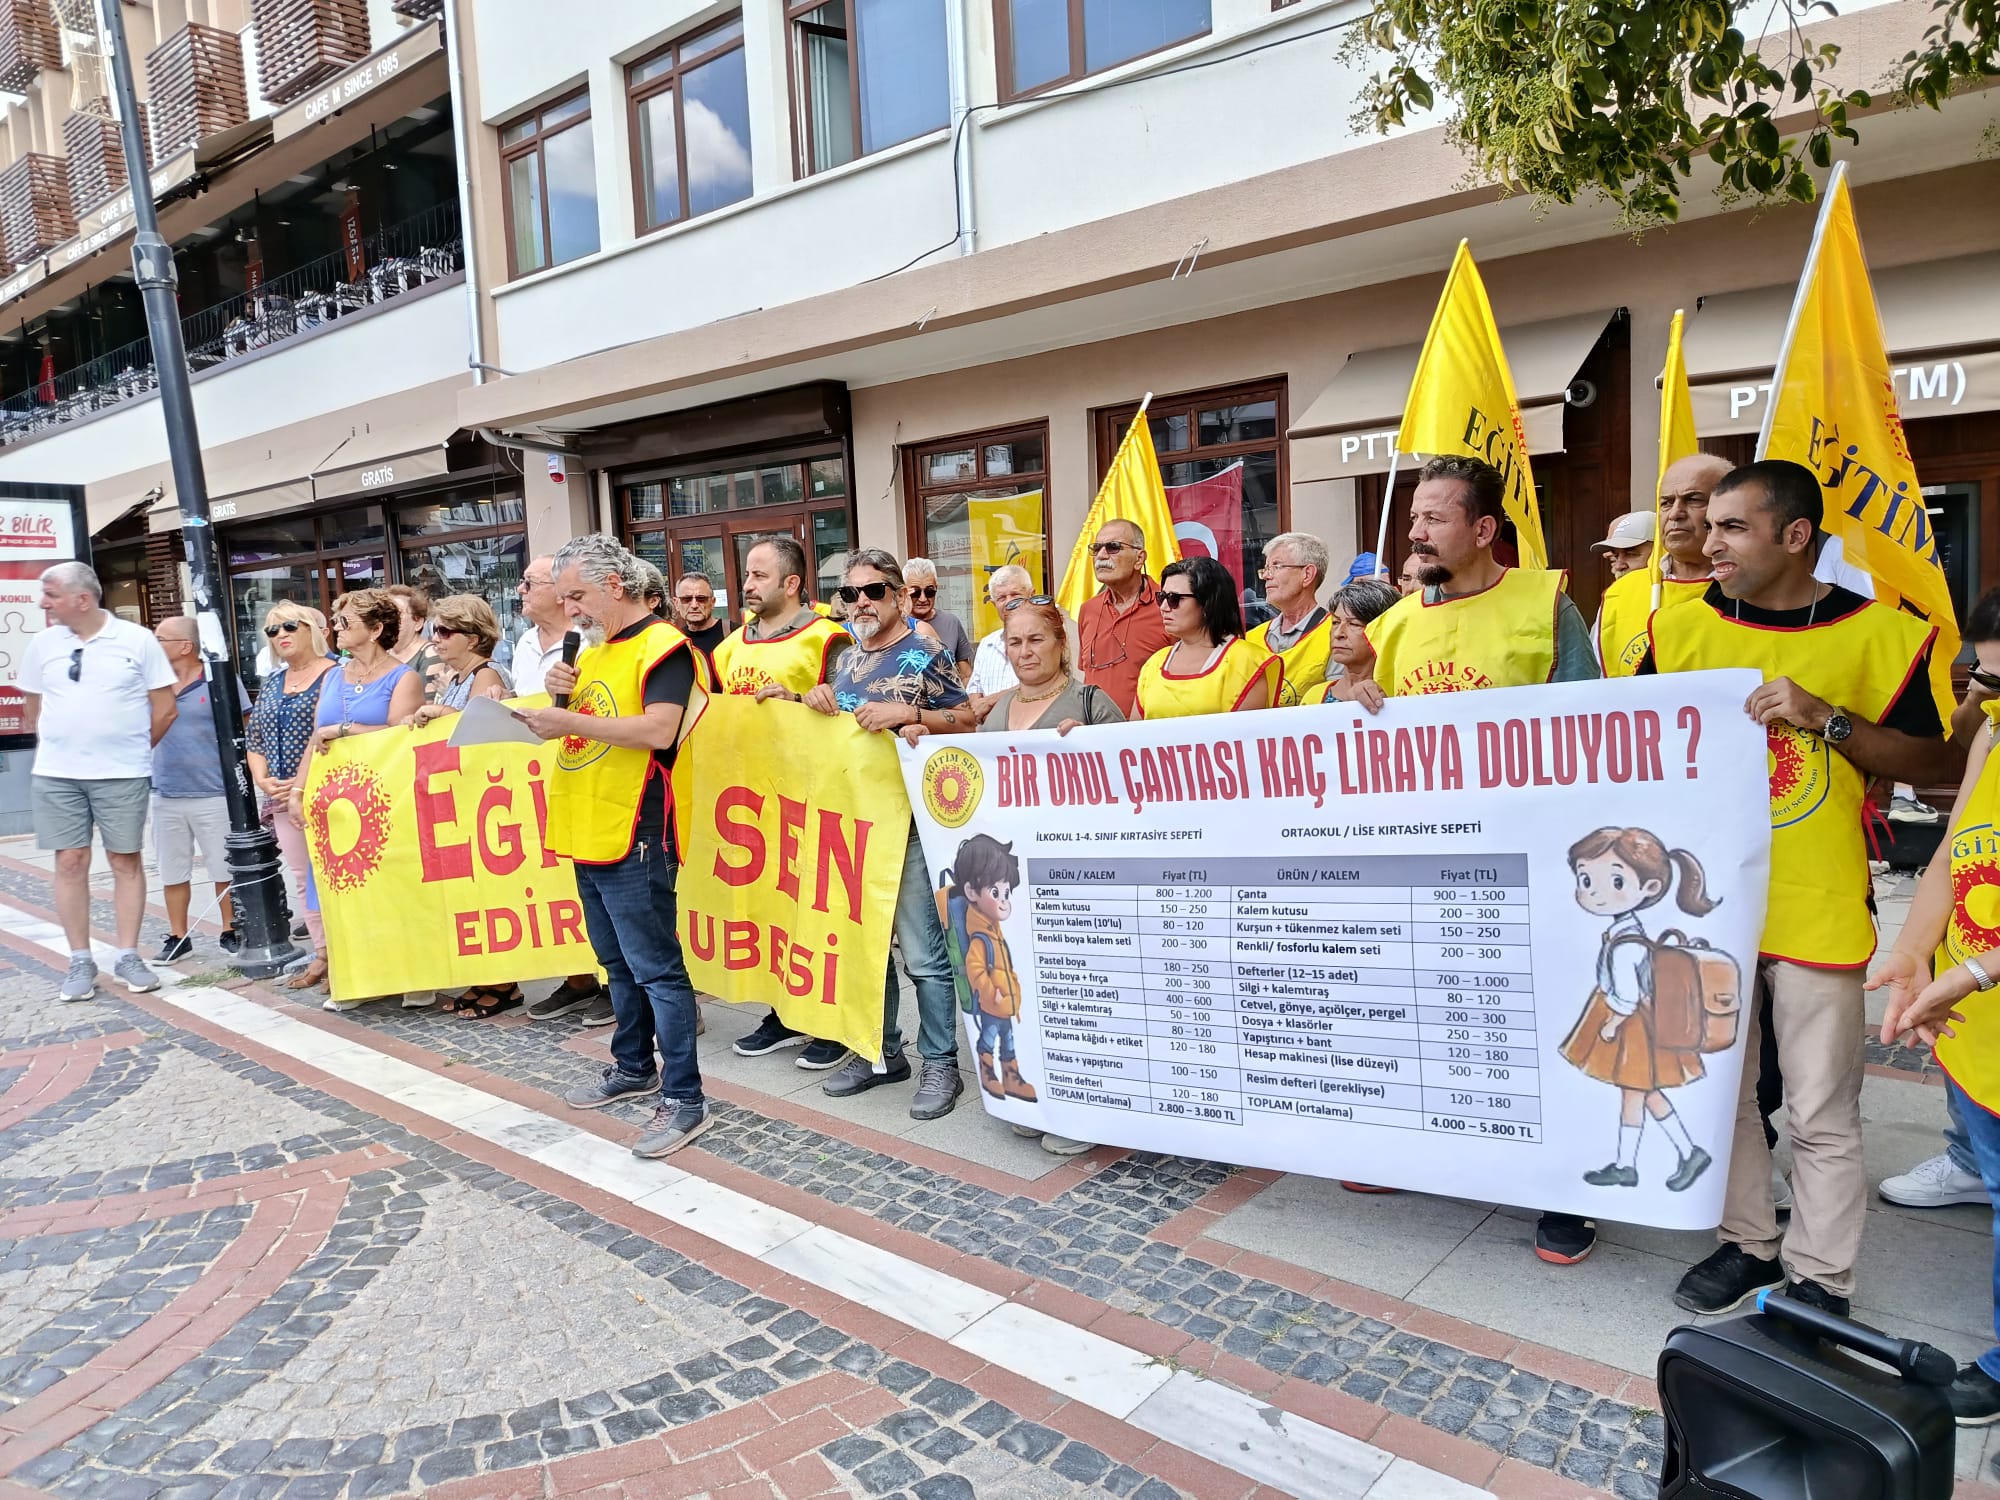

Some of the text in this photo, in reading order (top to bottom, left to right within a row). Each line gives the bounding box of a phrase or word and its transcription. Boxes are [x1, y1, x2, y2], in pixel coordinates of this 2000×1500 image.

[305, 52, 399, 119] CAFE M SINCE 1985
[100, 203, 119, 224] CAFE
[1341, 430, 1400, 463] PTT
[1462, 406, 1531, 518] EĞİT
[361, 465, 394, 487] GRATİS
[212, 500, 237, 519] GRATİS
[0, 594, 36, 604] KOKUL
[1624, 638, 1650, 666] EĞİ
[756, 670, 774, 685] SE
[1461, 665, 1494, 690] SE
[925, 752, 980, 783] EĞİTİM SEN
[996, 746, 1040, 808] BİR
[1046, 751, 1119, 806] OKUL
[1119, 740, 1250, 815] ÇANTASI
[1256, 734, 1327, 809] KAÇ
[1336, 718, 1464, 795] LİRAYA
[1476, 709, 1664, 789] DOLUYOR
[1677, 705, 1702, 780] ?
[413, 739, 560, 882] EĞİ
[712, 785, 874, 926] SEN
[1036, 832, 1074, 842] İLKOKUL
[1095, 831, 1119, 841] SINIF
[1121, 830, 1169, 841] KIRTASİYE
[1171, 830, 1203, 839] SEPETİ
[1282, 821, 1482, 838] ORTAOKUL LİSE KIRTASİYE SEPETİ
[1951, 836, 1999, 860] ĞİT
[1049, 869, 1116, 880] ÜRÜN KALEM
[1163, 870, 1208, 882] Fiyat (TL)
[1277, 868, 1361, 880] ÜRÜN KALEM
[1441, 868, 1498, 881] Fiyat (TL)
[1036, 888, 1060, 898] Çanta
[1156, 889, 1213, 899] 800 1.200
[1238, 889, 1268, 900] Çanta
[1434, 890, 1506, 901] 900 1.500
[1036, 902, 1091, 911] Kalem kutusu
[1237, 905, 1309, 916] Kalem kutusu
[1037, 917, 1065, 927] Kurşun
[1066, 918, 1093, 926] kalem
[1163, 920, 1204, 931] 80 120
[1237, 922, 1402, 936] Kurşun tükenmez kalem seti
[1038, 934, 1132, 946] Renkli boya kalem seti
[1441, 927, 1501, 938] 150 250
[454, 887, 840, 1005] EDİR UBESİ
[1237, 941, 1381, 955] Renkli/ fosforlu kalem seti
[1039, 956, 1089, 968] Pastel boya
[1164, 963, 1210, 974] 180 250
[1040, 970, 1109, 984] Sulu boya fırça
[1238, 967, 1285, 978] Defterler
[1328, 970, 1359, 983] adet)
[1437, 975, 1510, 988] 700 1.000
[1042, 986, 1120, 1001] Defterler (10 adet)
[1239, 983, 1330, 998] Silgi kalemtıraş
[1166, 994, 1213, 1006] 400 600
[1043, 1001, 1113, 1016] Silgi kalemtıraş
[1241, 999, 1406, 1020] Cetvel, gönye, açıölçer, pergel
[1044, 1015, 1098, 1028] Cetvel takımı
[1242, 1015, 1334, 1031] Dosya klasörler
[1445, 1011, 1507, 1024] 200 300
[1045, 1030, 1080, 1043] Kaplama
[1114, 1036, 1144, 1047] etiket
[1172, 1026, 1212, 1038] 80 120
[1243, 1031, 1333, 1048] Yapıştırıcı bant
[1047, 1052, 1124, 1069] Makas yapıştırıcı
[1245, 1047, 1399, 1071] Hesap makinesi (lise düzeyi)
[1448, 1047, 1509, 1061] 120 180
[1172, 1066, 1218, 1079] 100 150
[1050, 1073, 1103, 1088] Resim defteri
[1247, 1073, 1386, 1098] Resim defteri (gerekliyse)
[1051, 1088, 1132, 1108] TOPLAM (ortalama)
[1159, 1103, 1236, 1121] 2.800 3.800 TL
[1248, 1097, 1354, 1120] TOPLAM (ortalama)
[1432, 1118, 1534, 1138] 4.000 5.800 TL
